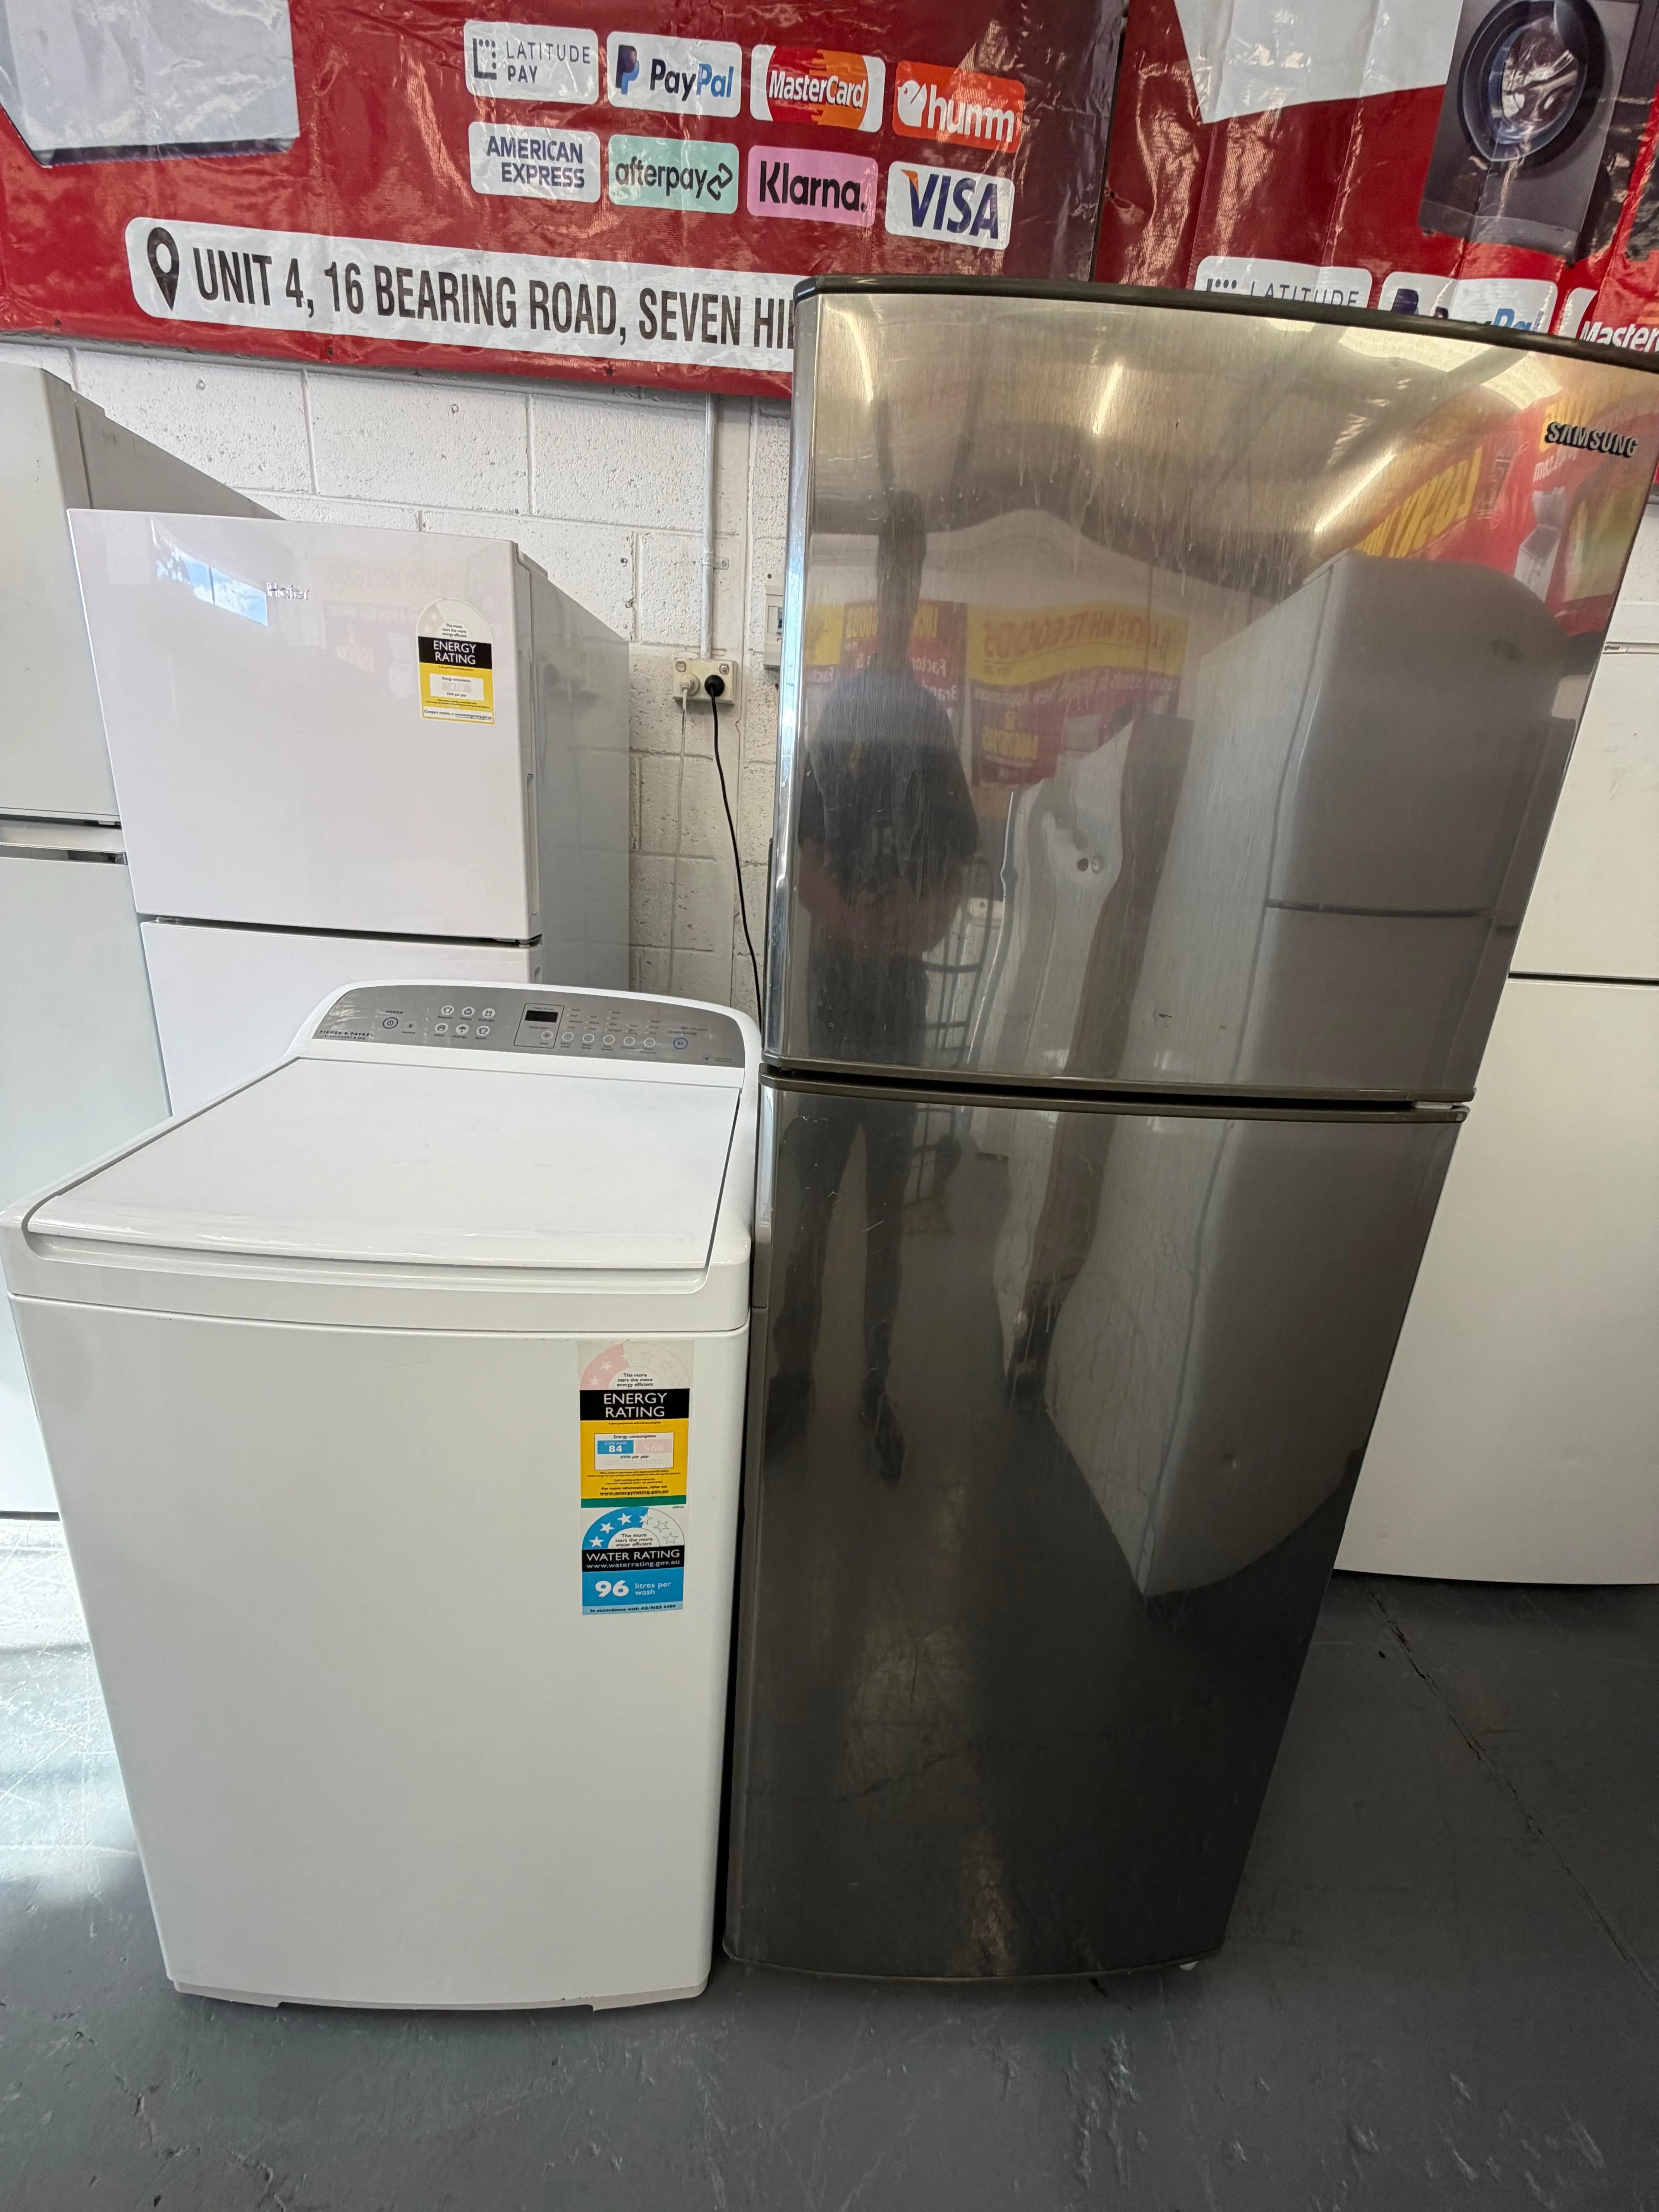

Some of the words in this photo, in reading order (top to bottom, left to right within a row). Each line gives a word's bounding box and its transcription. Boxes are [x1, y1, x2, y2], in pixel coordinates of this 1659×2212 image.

[506, 40, 591, 65] LATITUDE
[507, 65, 538, 84] PAY
[649, 58, 734, 102] PayPal
[768, 70, 867, 108] MasterCard
[927, 84, 1015, 143] humm
[486, 136, 583, 164] AMERICAN
[501, 161, 585, 189] EXPRESS
[615, 156, 708, 199] afterpay
[901, 169, 999, 239] VISA
[192, 247, 273, 306] UNIT
[285, 258, 315, 318] 4,
[324, 261, 364, 314] 16
[374, 264, 517, 328] BEARING
[529, 279, 626, 346] ROAD,
[639, 287, 741, 346] SEVEN
[1545, 421, 1638, 458] SAMSUNG
[433, 640, 477, 654] ENERGY
[435, 651, 476, 665] RATING
[603, 1392, 668, 1405] ENERGY
[605, 1406, 665, 1418] RATING
[586, 1552, 630, 1562] WATER
[634, 1549, 680, 1560] RATING
[586, 1559, 680, 1569] www.waterrating.gov.au
[595, 1580, 629, 1597] 96
